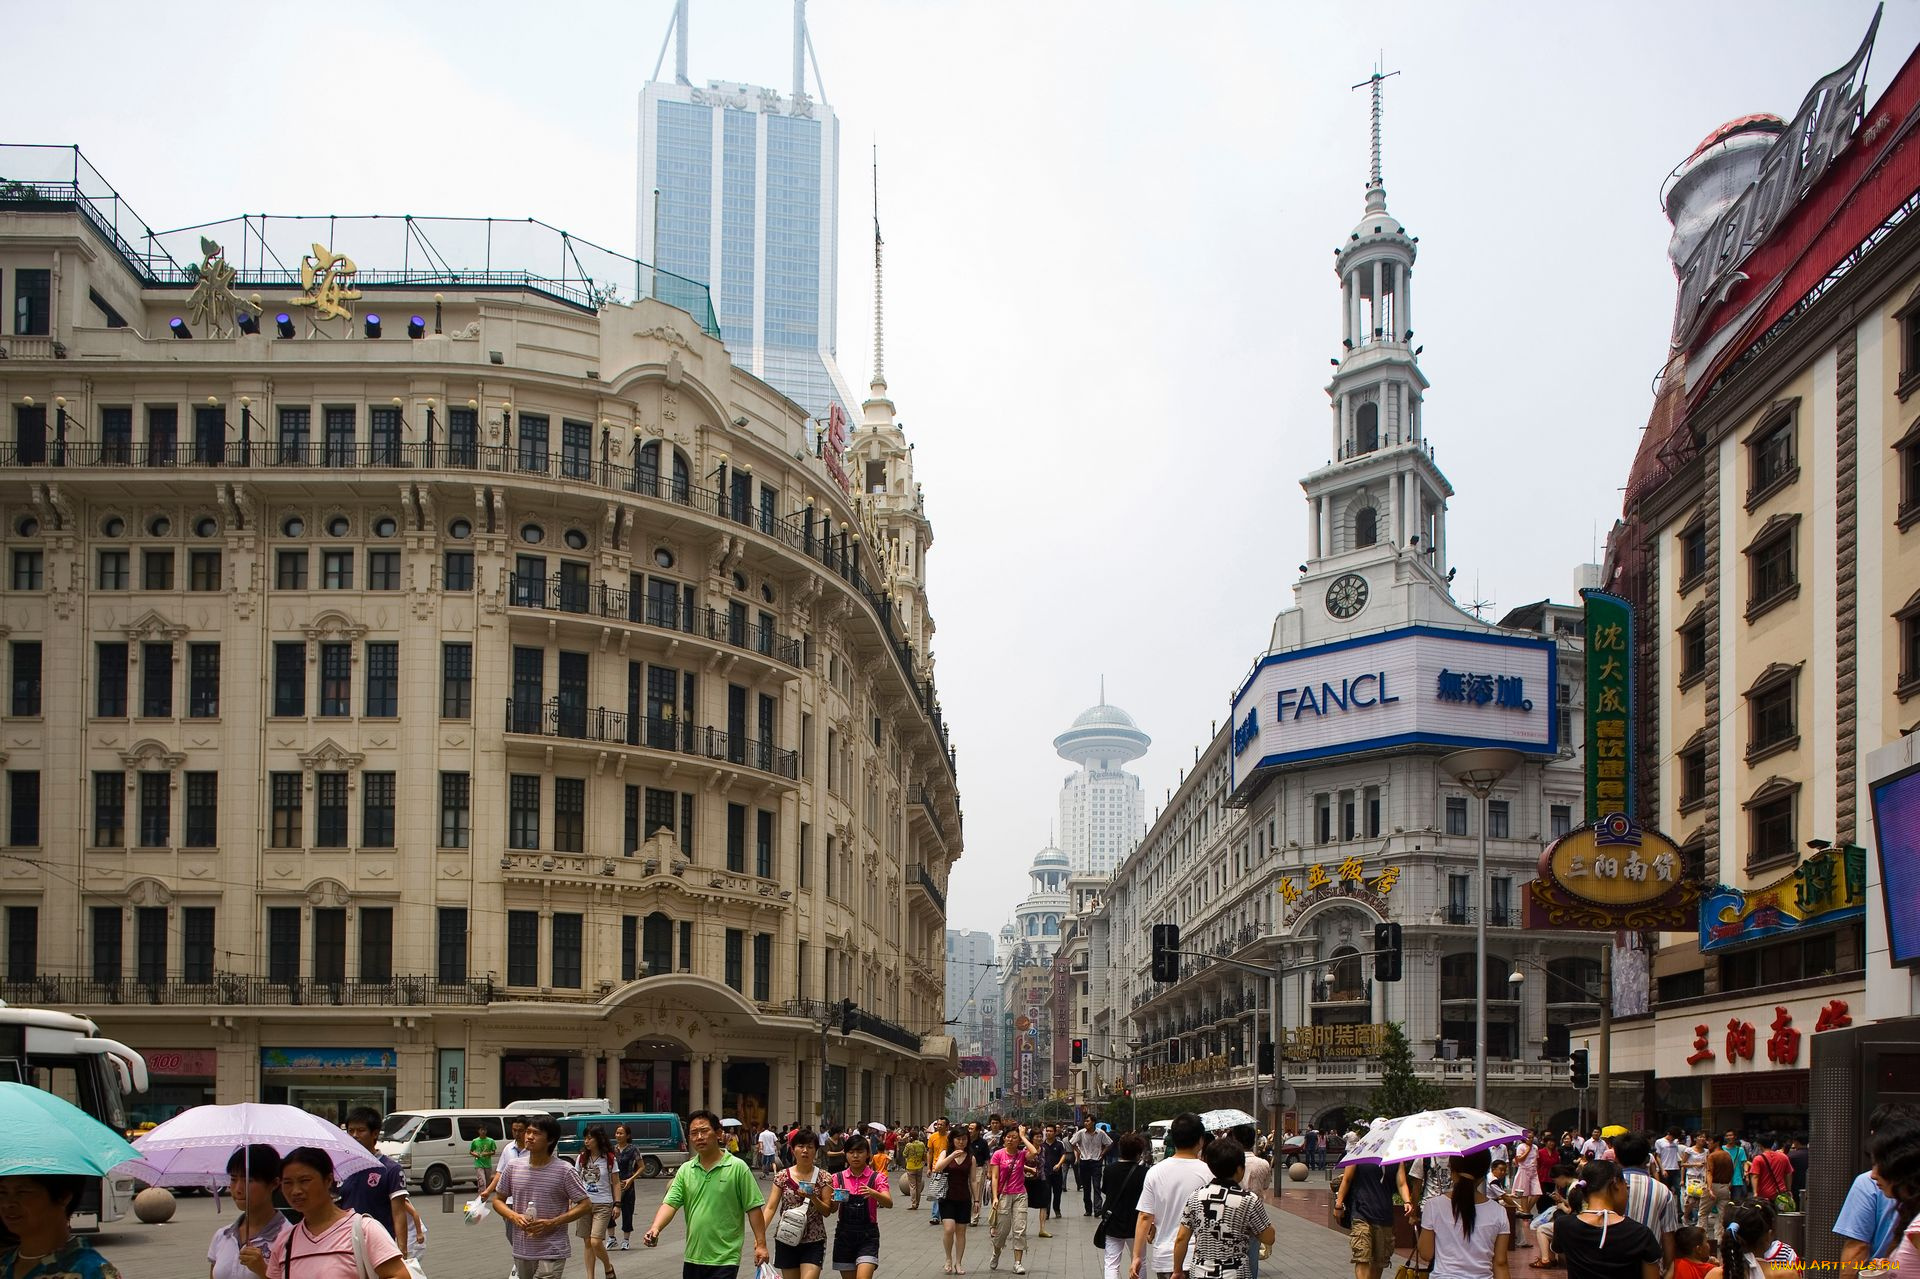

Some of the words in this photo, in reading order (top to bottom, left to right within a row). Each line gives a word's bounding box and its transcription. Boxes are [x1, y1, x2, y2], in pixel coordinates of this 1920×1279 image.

[1594, 622, 1626, 714] 沈大成
[1277, 671, 1399, 722] FANCL
[1566, 850, 1677, 882] 三阳南货
[1316, 885, 1347, 901] ASIA
[150, 1053, 182, 1070] 100
[1323, 1046, 1362, 1057] FASHION
[448, 1066, 459, 1111] 周生
